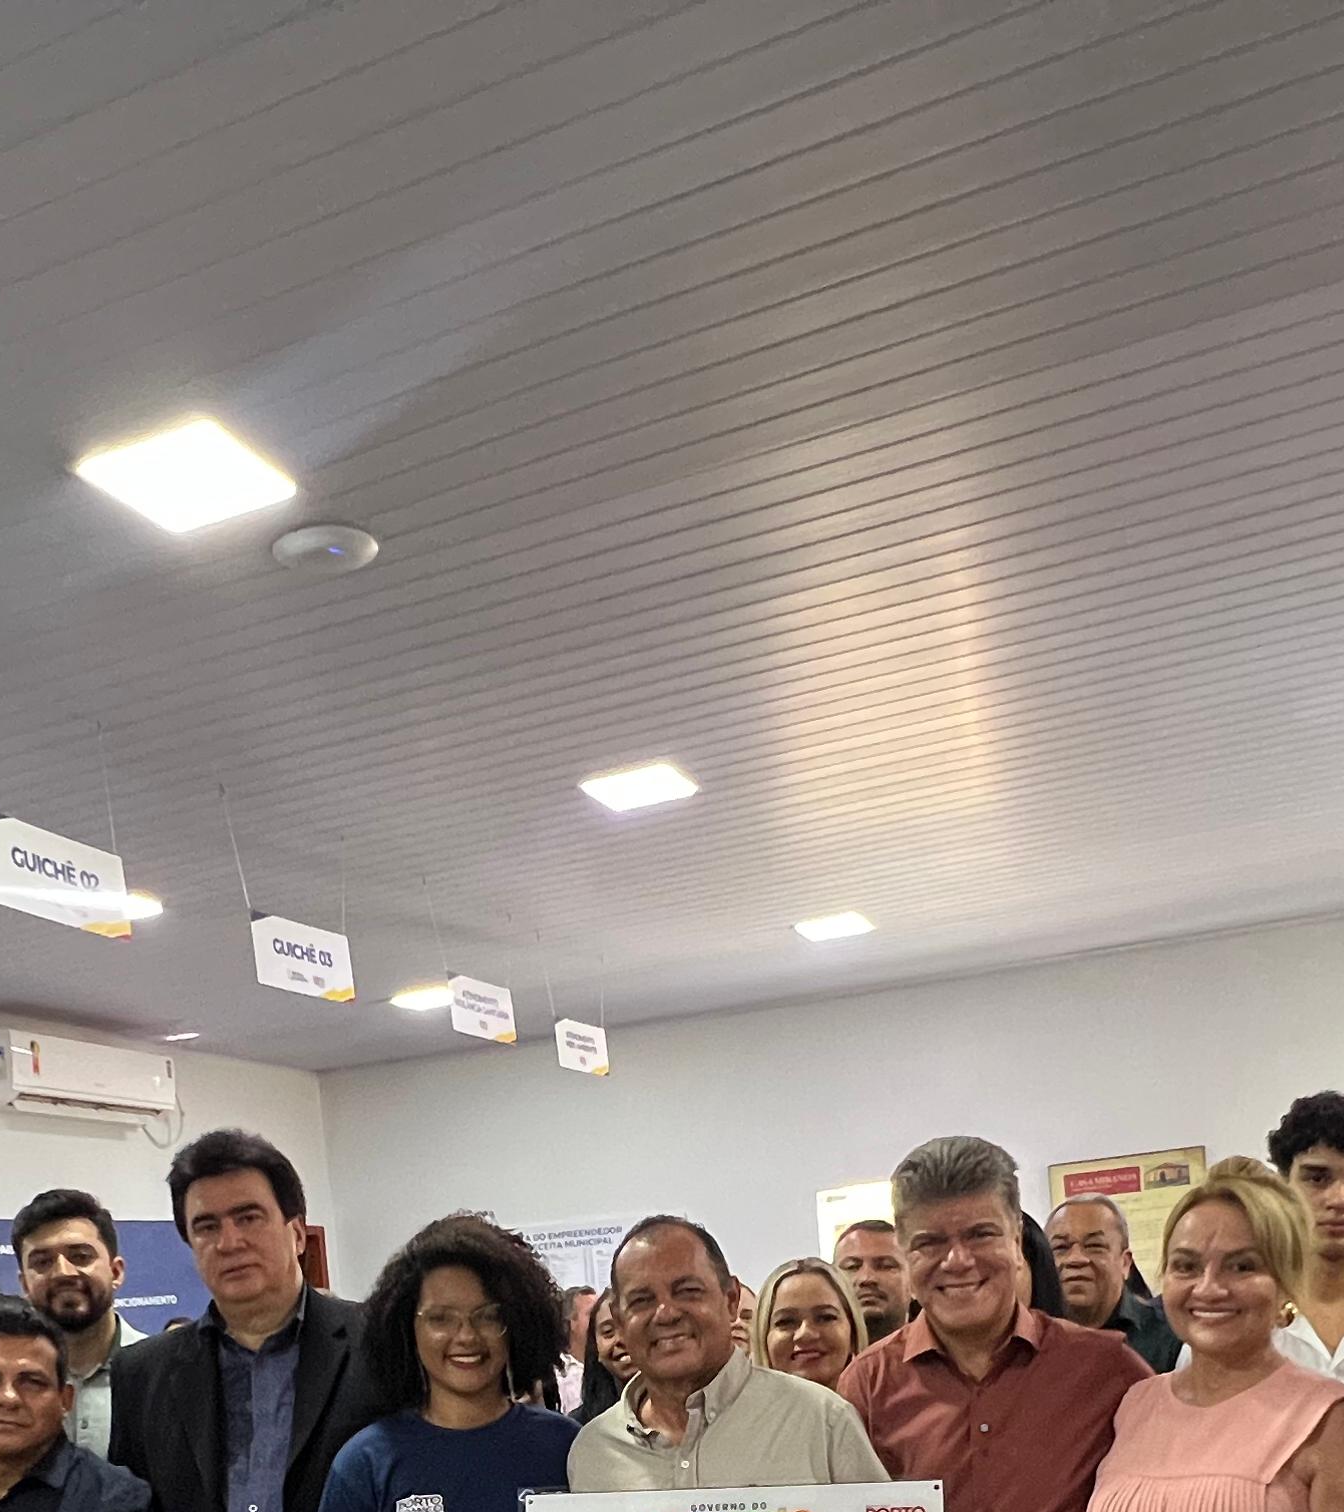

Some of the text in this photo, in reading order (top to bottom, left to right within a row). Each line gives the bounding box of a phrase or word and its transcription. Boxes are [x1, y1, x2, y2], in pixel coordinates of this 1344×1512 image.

[11, 846, 99, 892] GUICHÊ 02
[272, 938, 333, 968] GUICHÊ 03
[548, 1226, 623, 1240] EMPREENDEDOR
[564, 1237, 613, 1248] MUNICIPAL
[690, 1501, 768, 1512] GOVERNO DO
